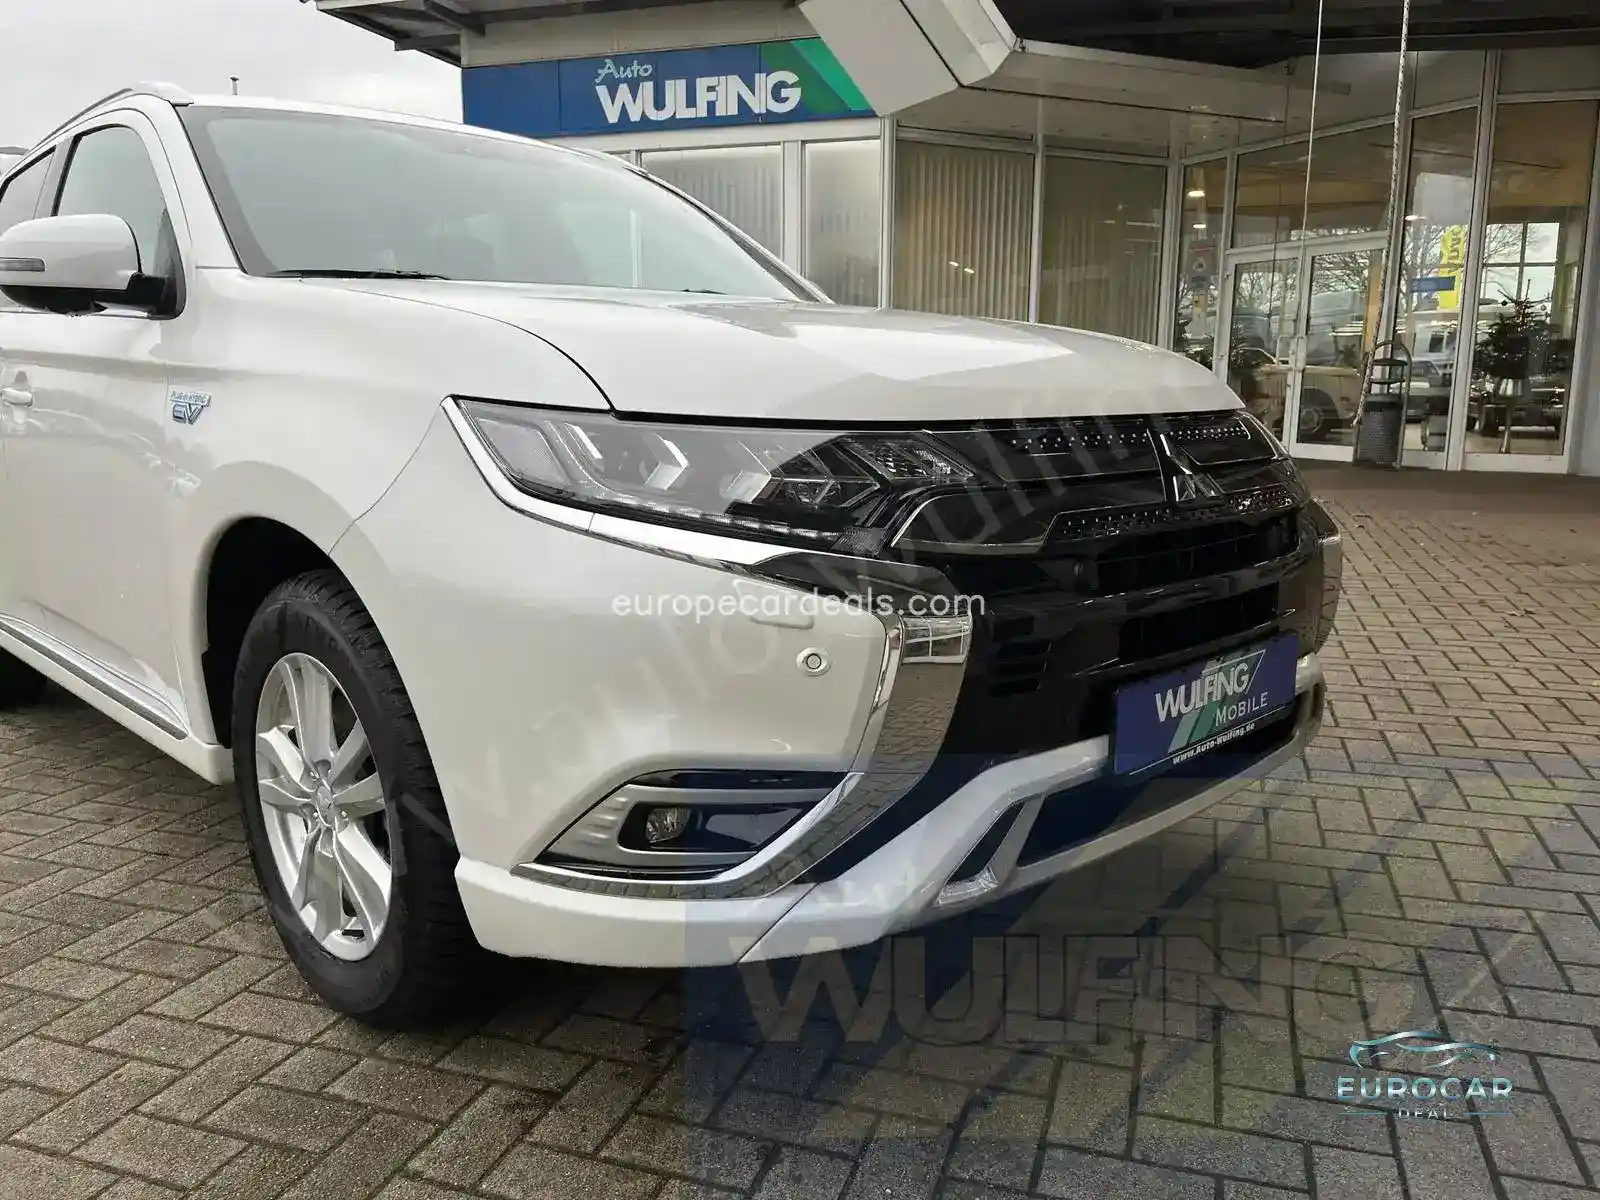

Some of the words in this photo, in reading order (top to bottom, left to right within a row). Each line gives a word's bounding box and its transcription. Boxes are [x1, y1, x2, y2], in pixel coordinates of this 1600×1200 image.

[595, 59, 653, 83] Auto
[595, 70, 802, 124] WULFING
[1156, 662, 1249, 722] WULFING
